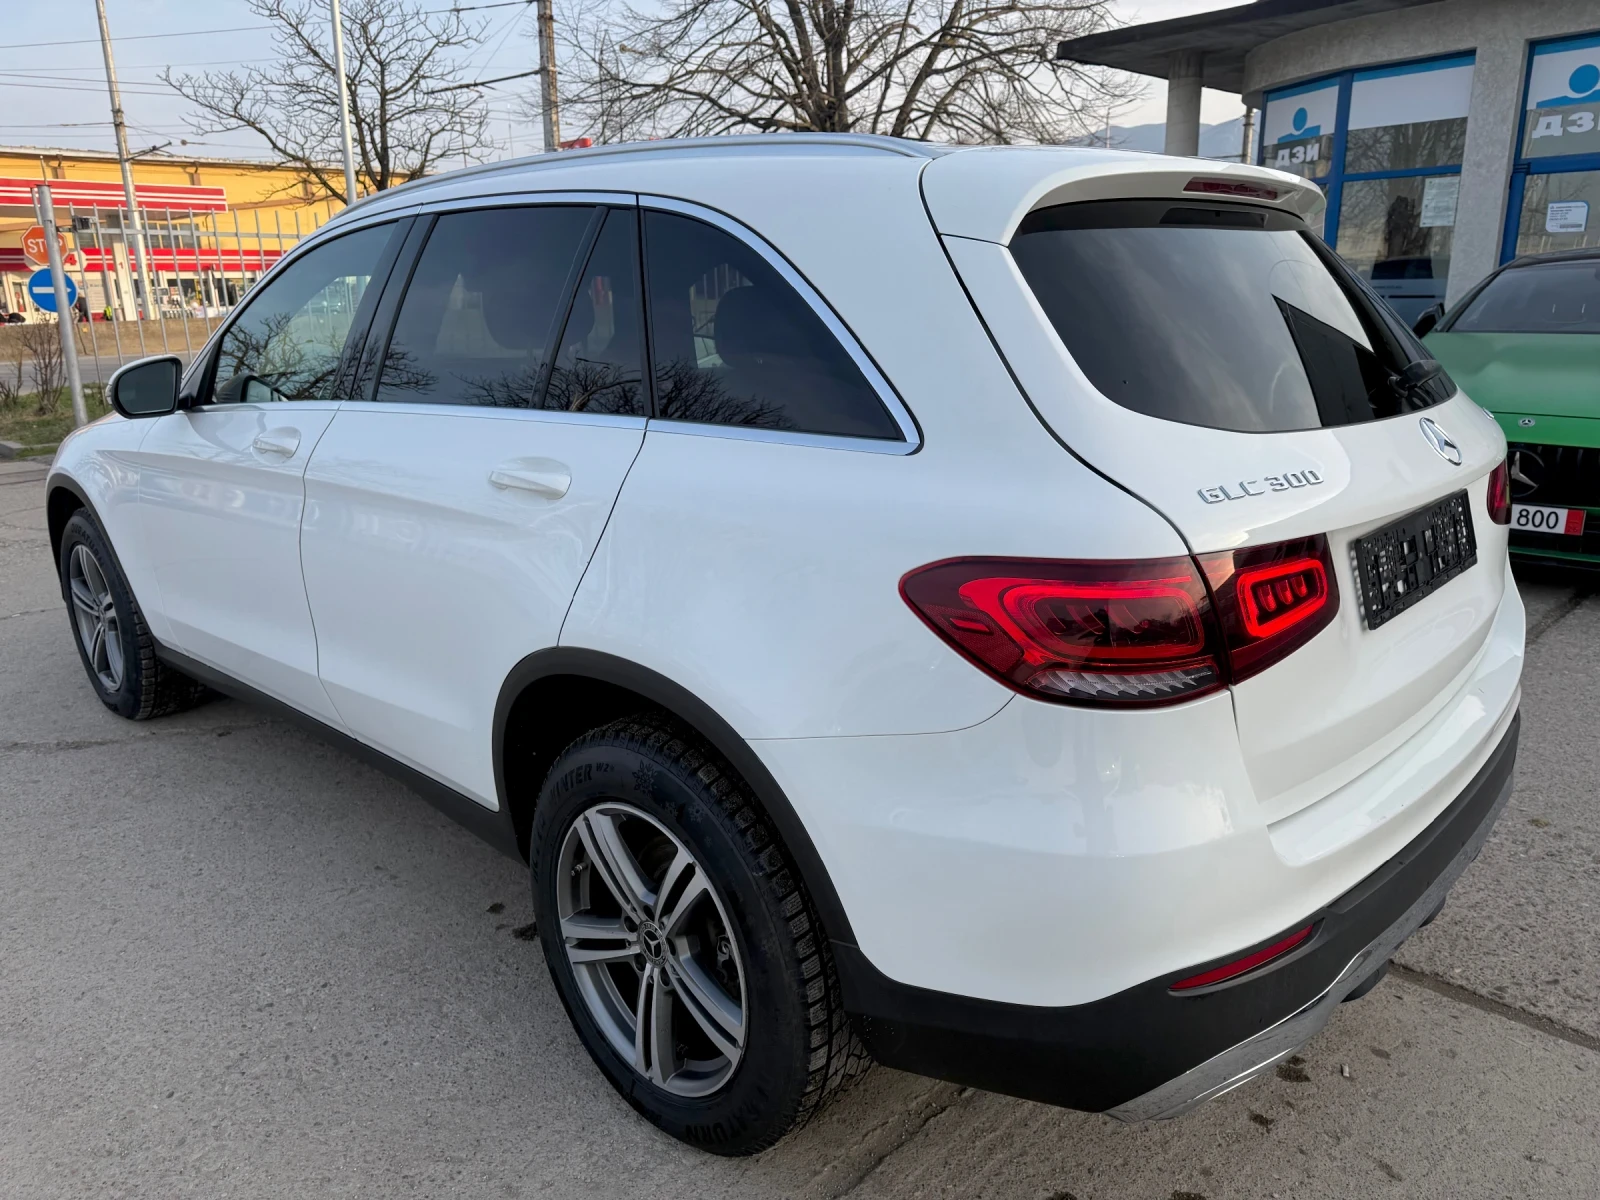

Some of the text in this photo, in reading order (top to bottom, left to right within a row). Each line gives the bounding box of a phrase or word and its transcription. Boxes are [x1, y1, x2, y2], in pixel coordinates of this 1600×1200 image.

[1532, 111, 1600, 139] ДЗ
[1275, 143, 1320, 168] ДЗИ
[27, 238, 63, 253] ST
[1197, 469, 1324, 504] GLC 300
[1516, 508, 1560, 530] 800
[549, 763, 593, 804] WINTER
